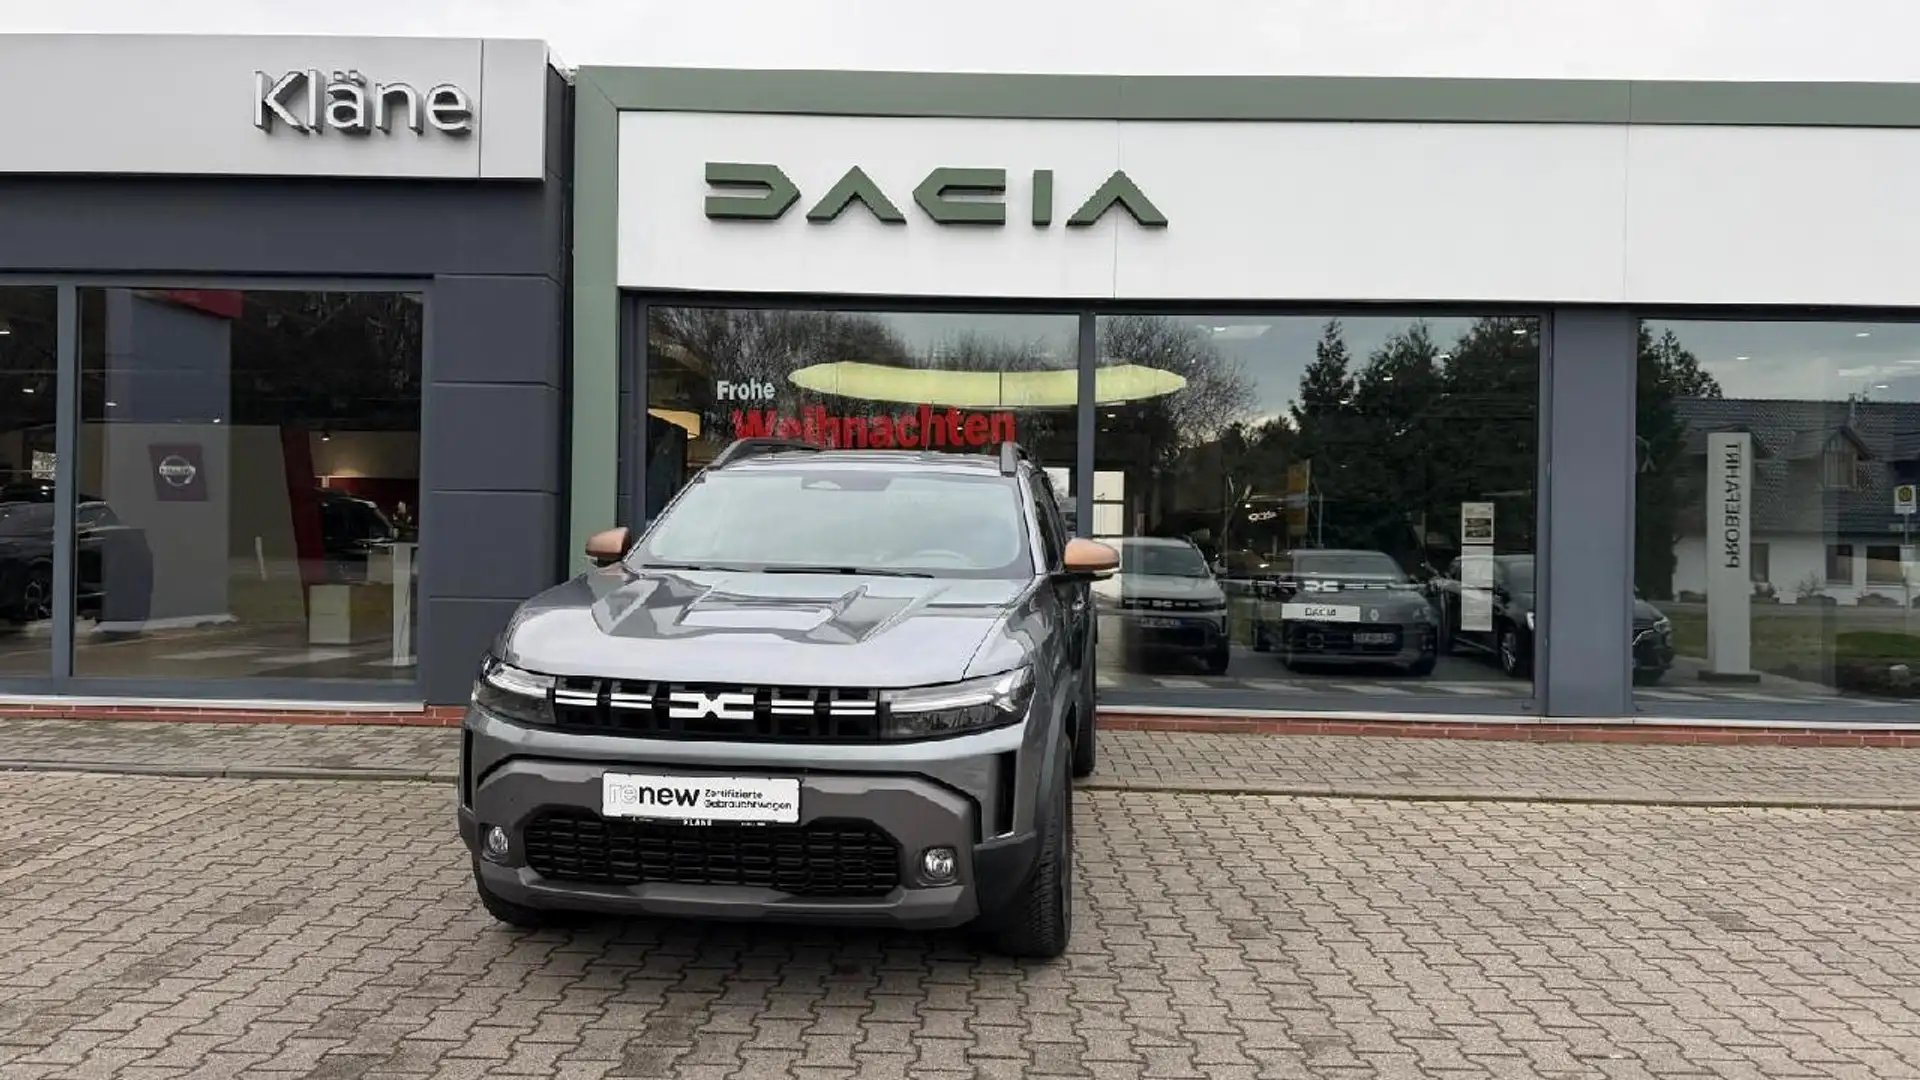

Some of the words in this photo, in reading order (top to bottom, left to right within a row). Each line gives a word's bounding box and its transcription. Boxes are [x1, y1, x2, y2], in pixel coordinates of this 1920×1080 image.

[254, 69, 473, 136] Kläne
[705, 162, 1169, 228] DACIA
[717, 380, 776, 401] Frohe
[731, 402, 1017, 449] Weihnachten
